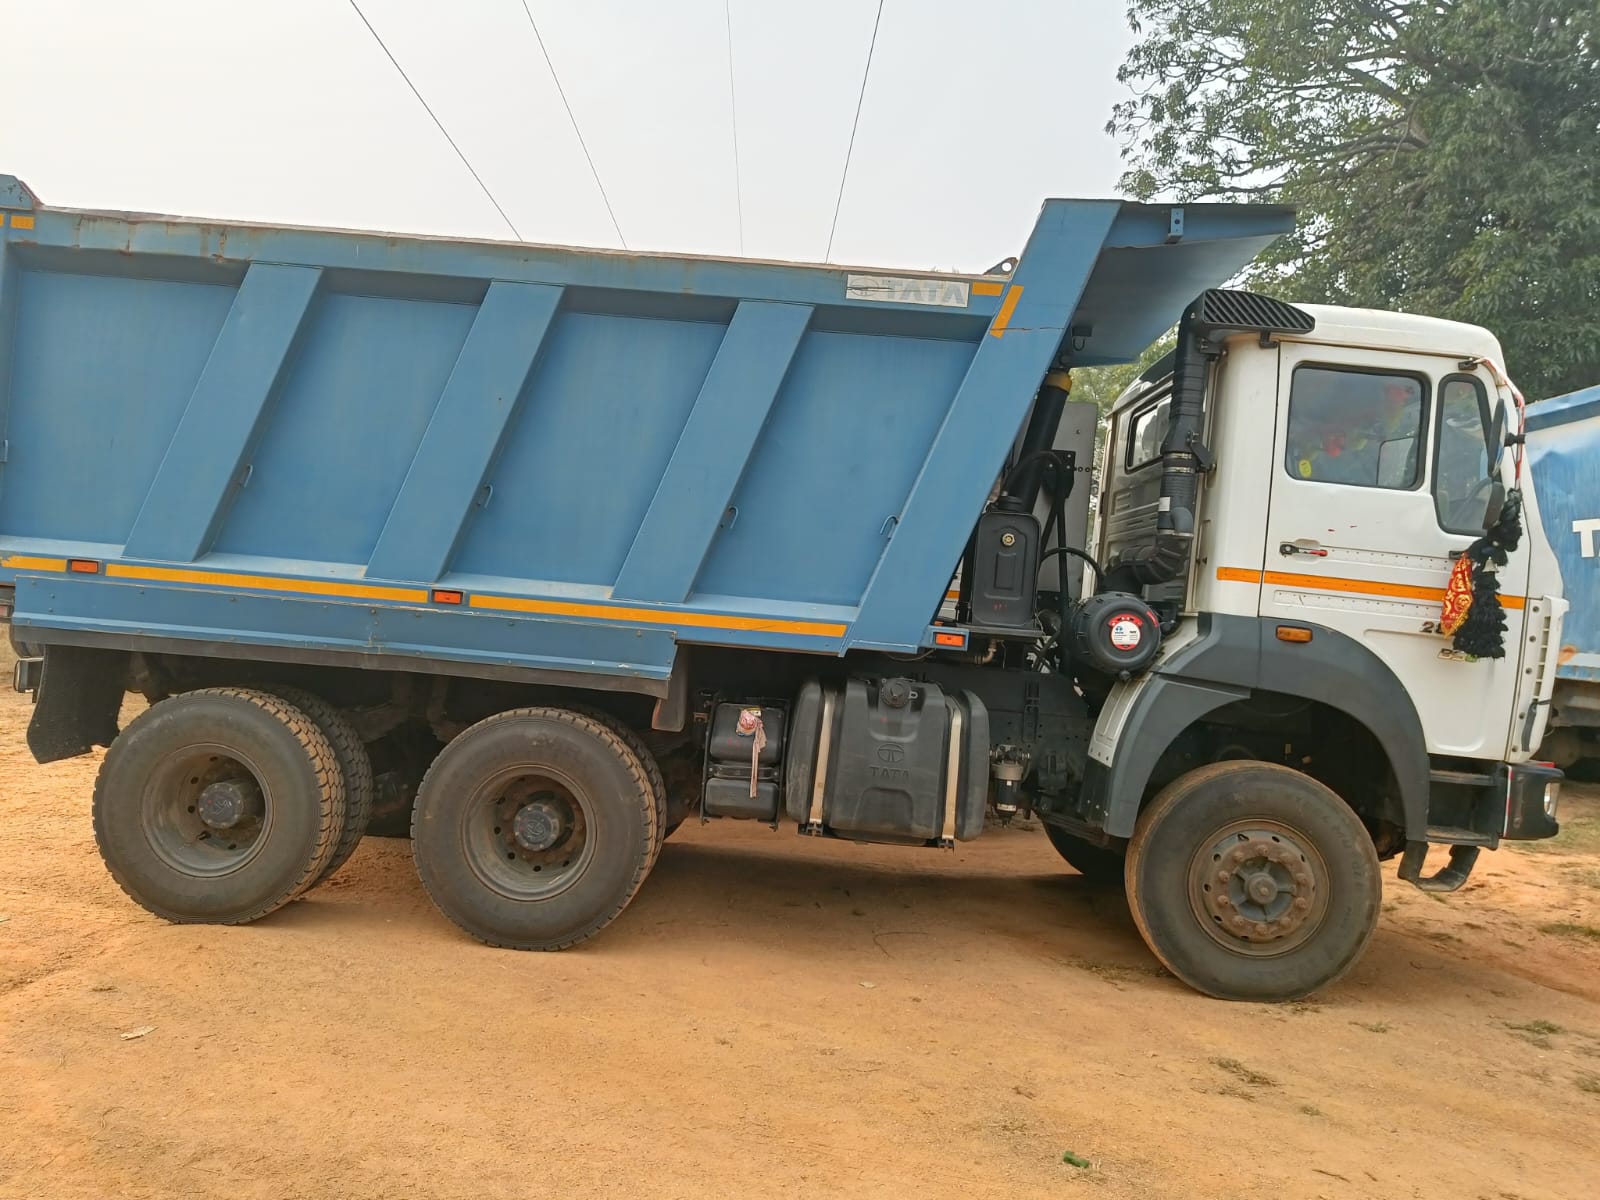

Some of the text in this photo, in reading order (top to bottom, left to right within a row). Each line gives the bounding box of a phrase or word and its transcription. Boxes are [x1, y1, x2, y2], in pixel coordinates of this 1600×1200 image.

[882, 279, 965, 304] TATA
[1572, 519, 1600, 557] T
[869, 766, 909, 782] TATA
